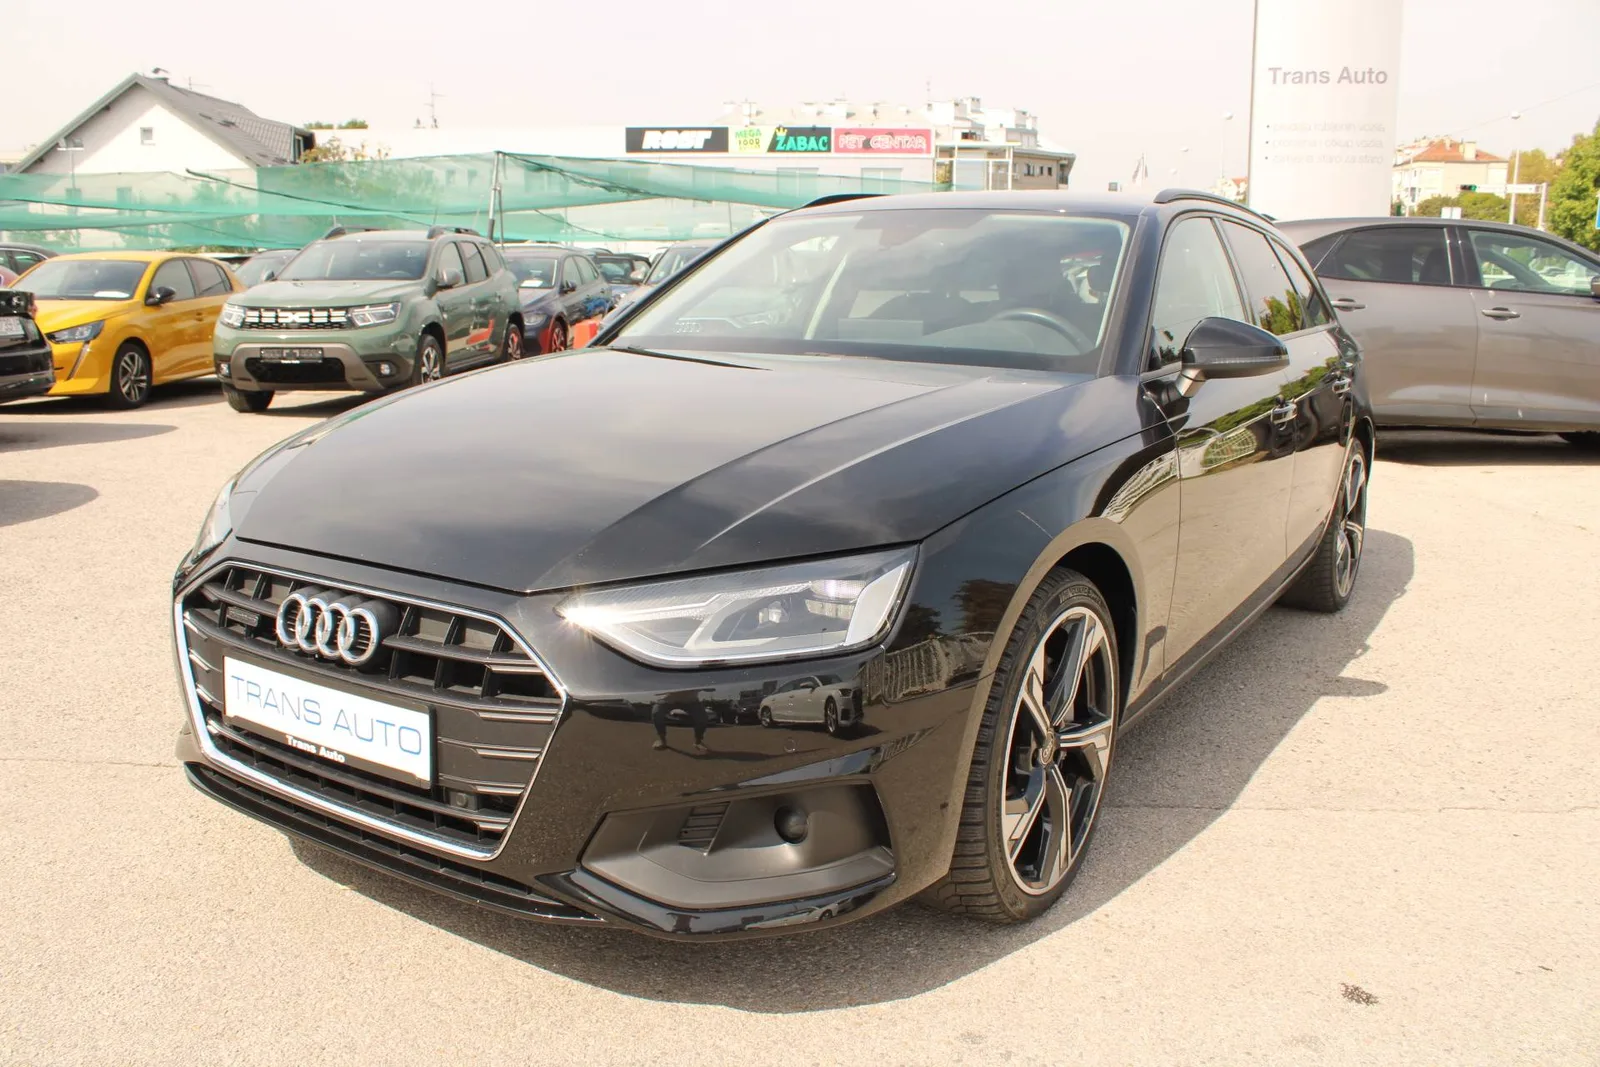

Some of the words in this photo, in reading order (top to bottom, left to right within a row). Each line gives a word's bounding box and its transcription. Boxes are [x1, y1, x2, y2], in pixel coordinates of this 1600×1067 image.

[1268, 67, 1330, 84] Trans
[1337, 66, 1388, 84] Auto
[838, 134, 866, 149] PET
[231, 675, 322, 725] TRANS
[333, 709, 421, 755] AUTO
[286, 735, 316, 754] Trans
[319, 746, 345, 763] Auto
